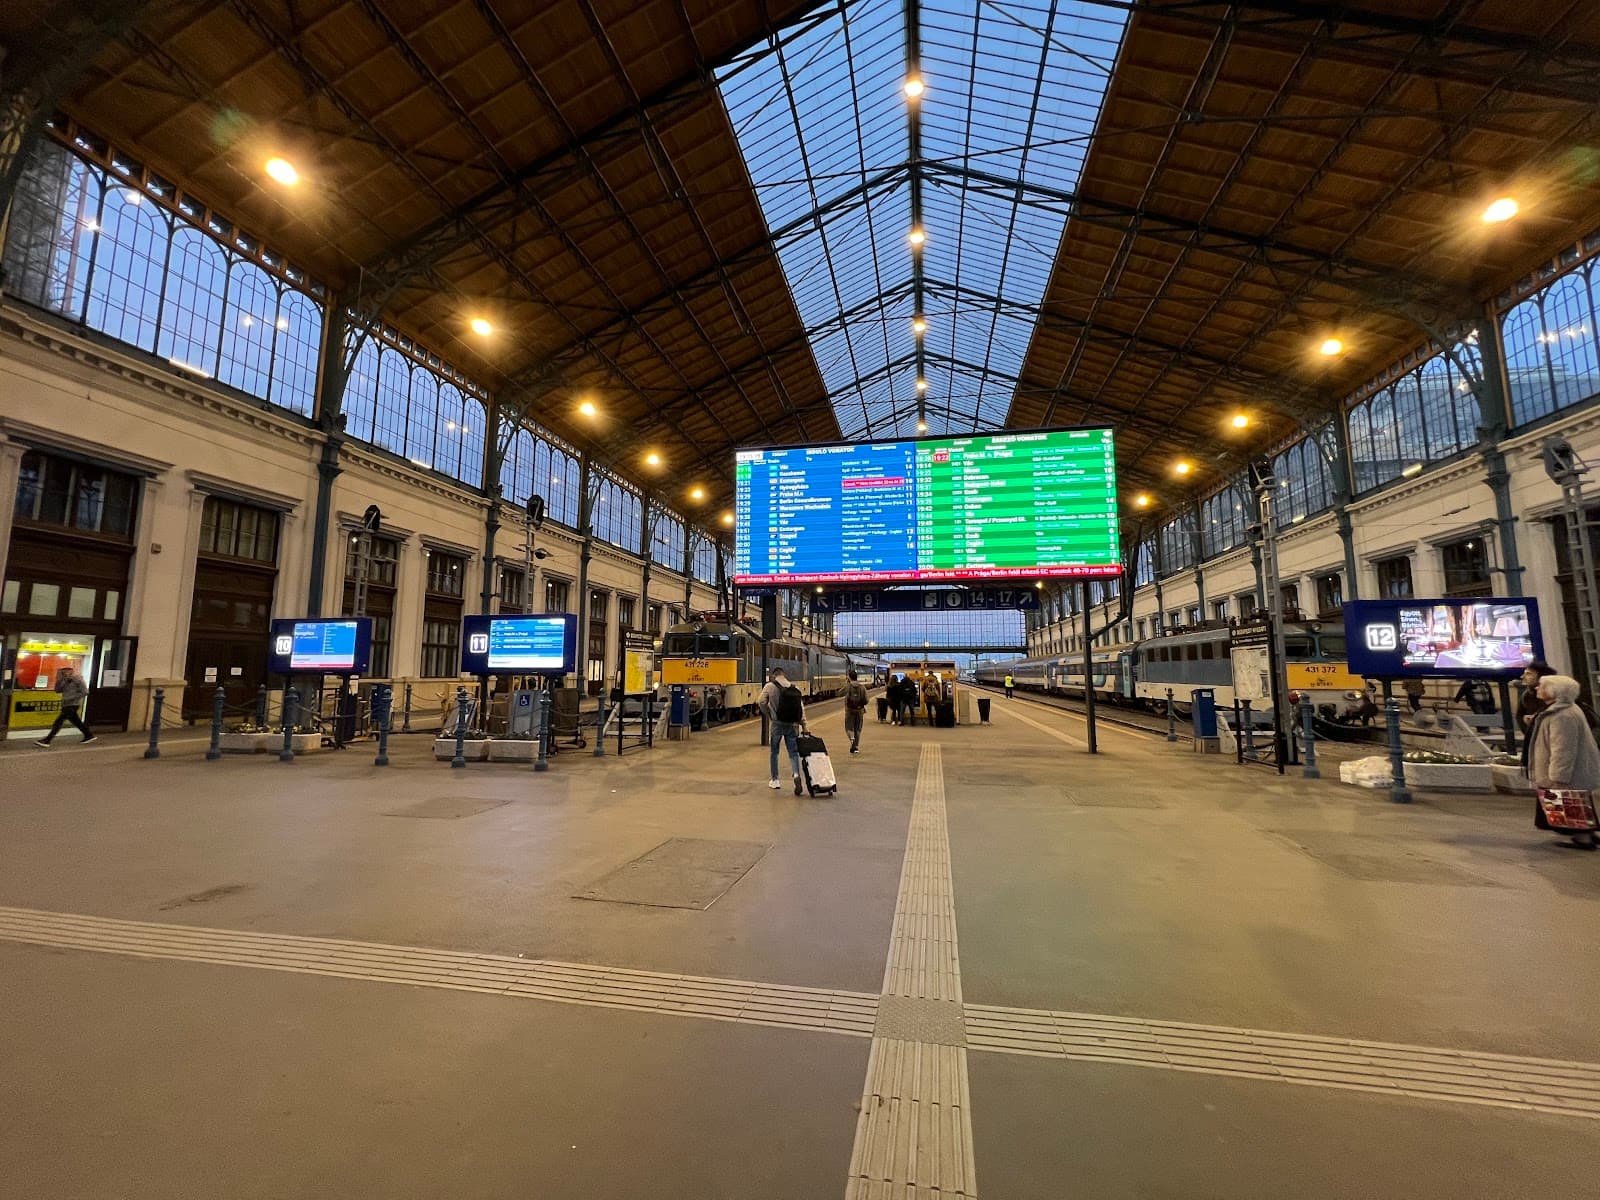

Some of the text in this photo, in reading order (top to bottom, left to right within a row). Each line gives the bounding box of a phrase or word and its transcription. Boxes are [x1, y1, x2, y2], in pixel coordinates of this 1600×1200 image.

[864, 594, 872, 605] 9
[970, 591, 1013, 603] 14 17
[473, 637, 485, 650] 11
[1369, 629, 1393, 645] 12
[279, 639, 290, 652] 10
